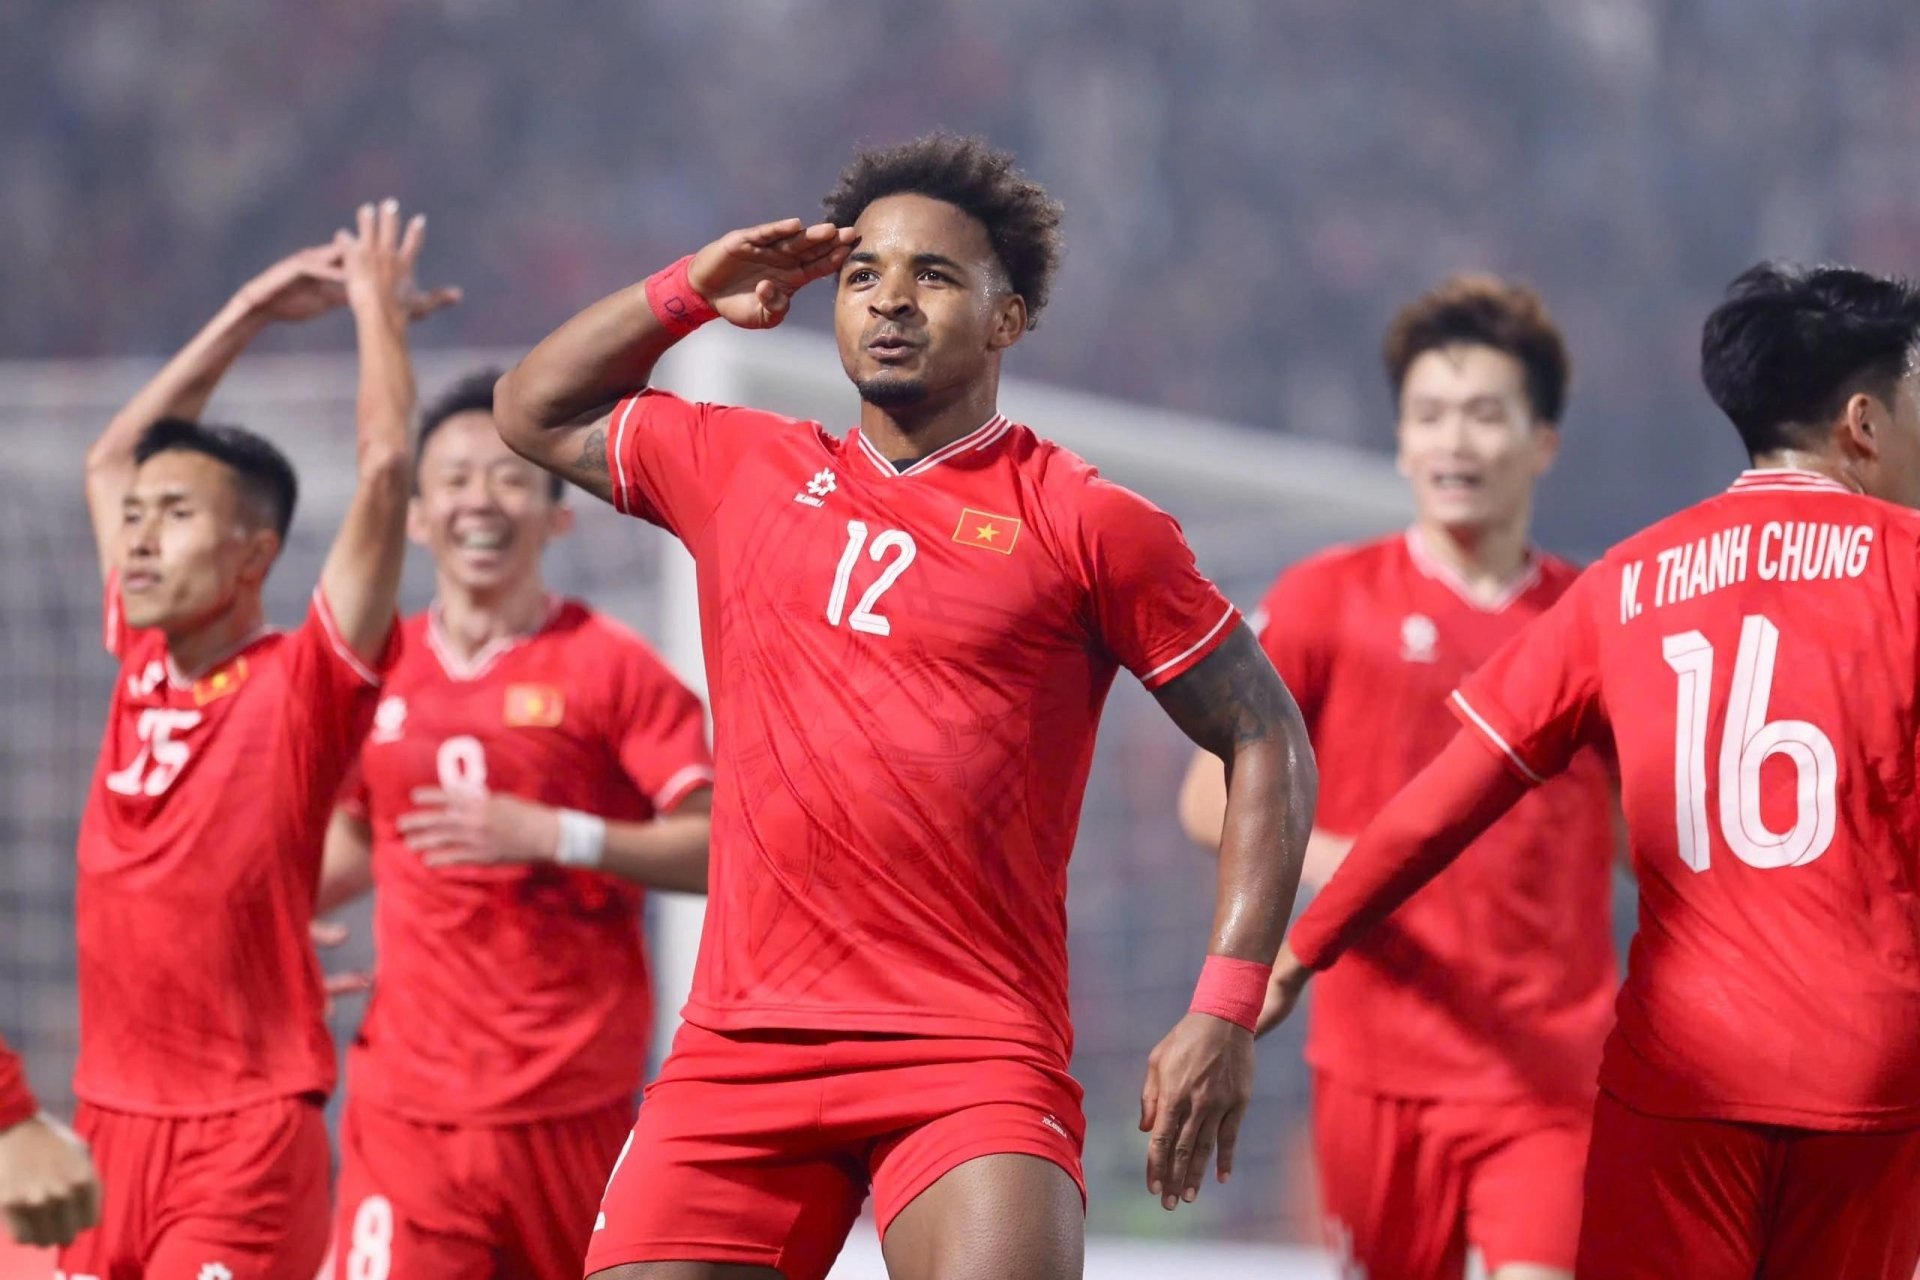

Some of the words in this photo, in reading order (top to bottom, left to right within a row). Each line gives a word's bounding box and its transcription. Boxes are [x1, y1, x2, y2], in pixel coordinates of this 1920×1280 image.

[826, 519, 917, 637] 12
[1620, 561, 1643, 625] N.
[1654, 525, 1752, 608] THANH
[1757, 521, 1873, 582] CHUNG
[106, 708, 203, 797] 15
[1662, 613, 1838, 873] 16
[346, 1195, 394, 1280] 8
